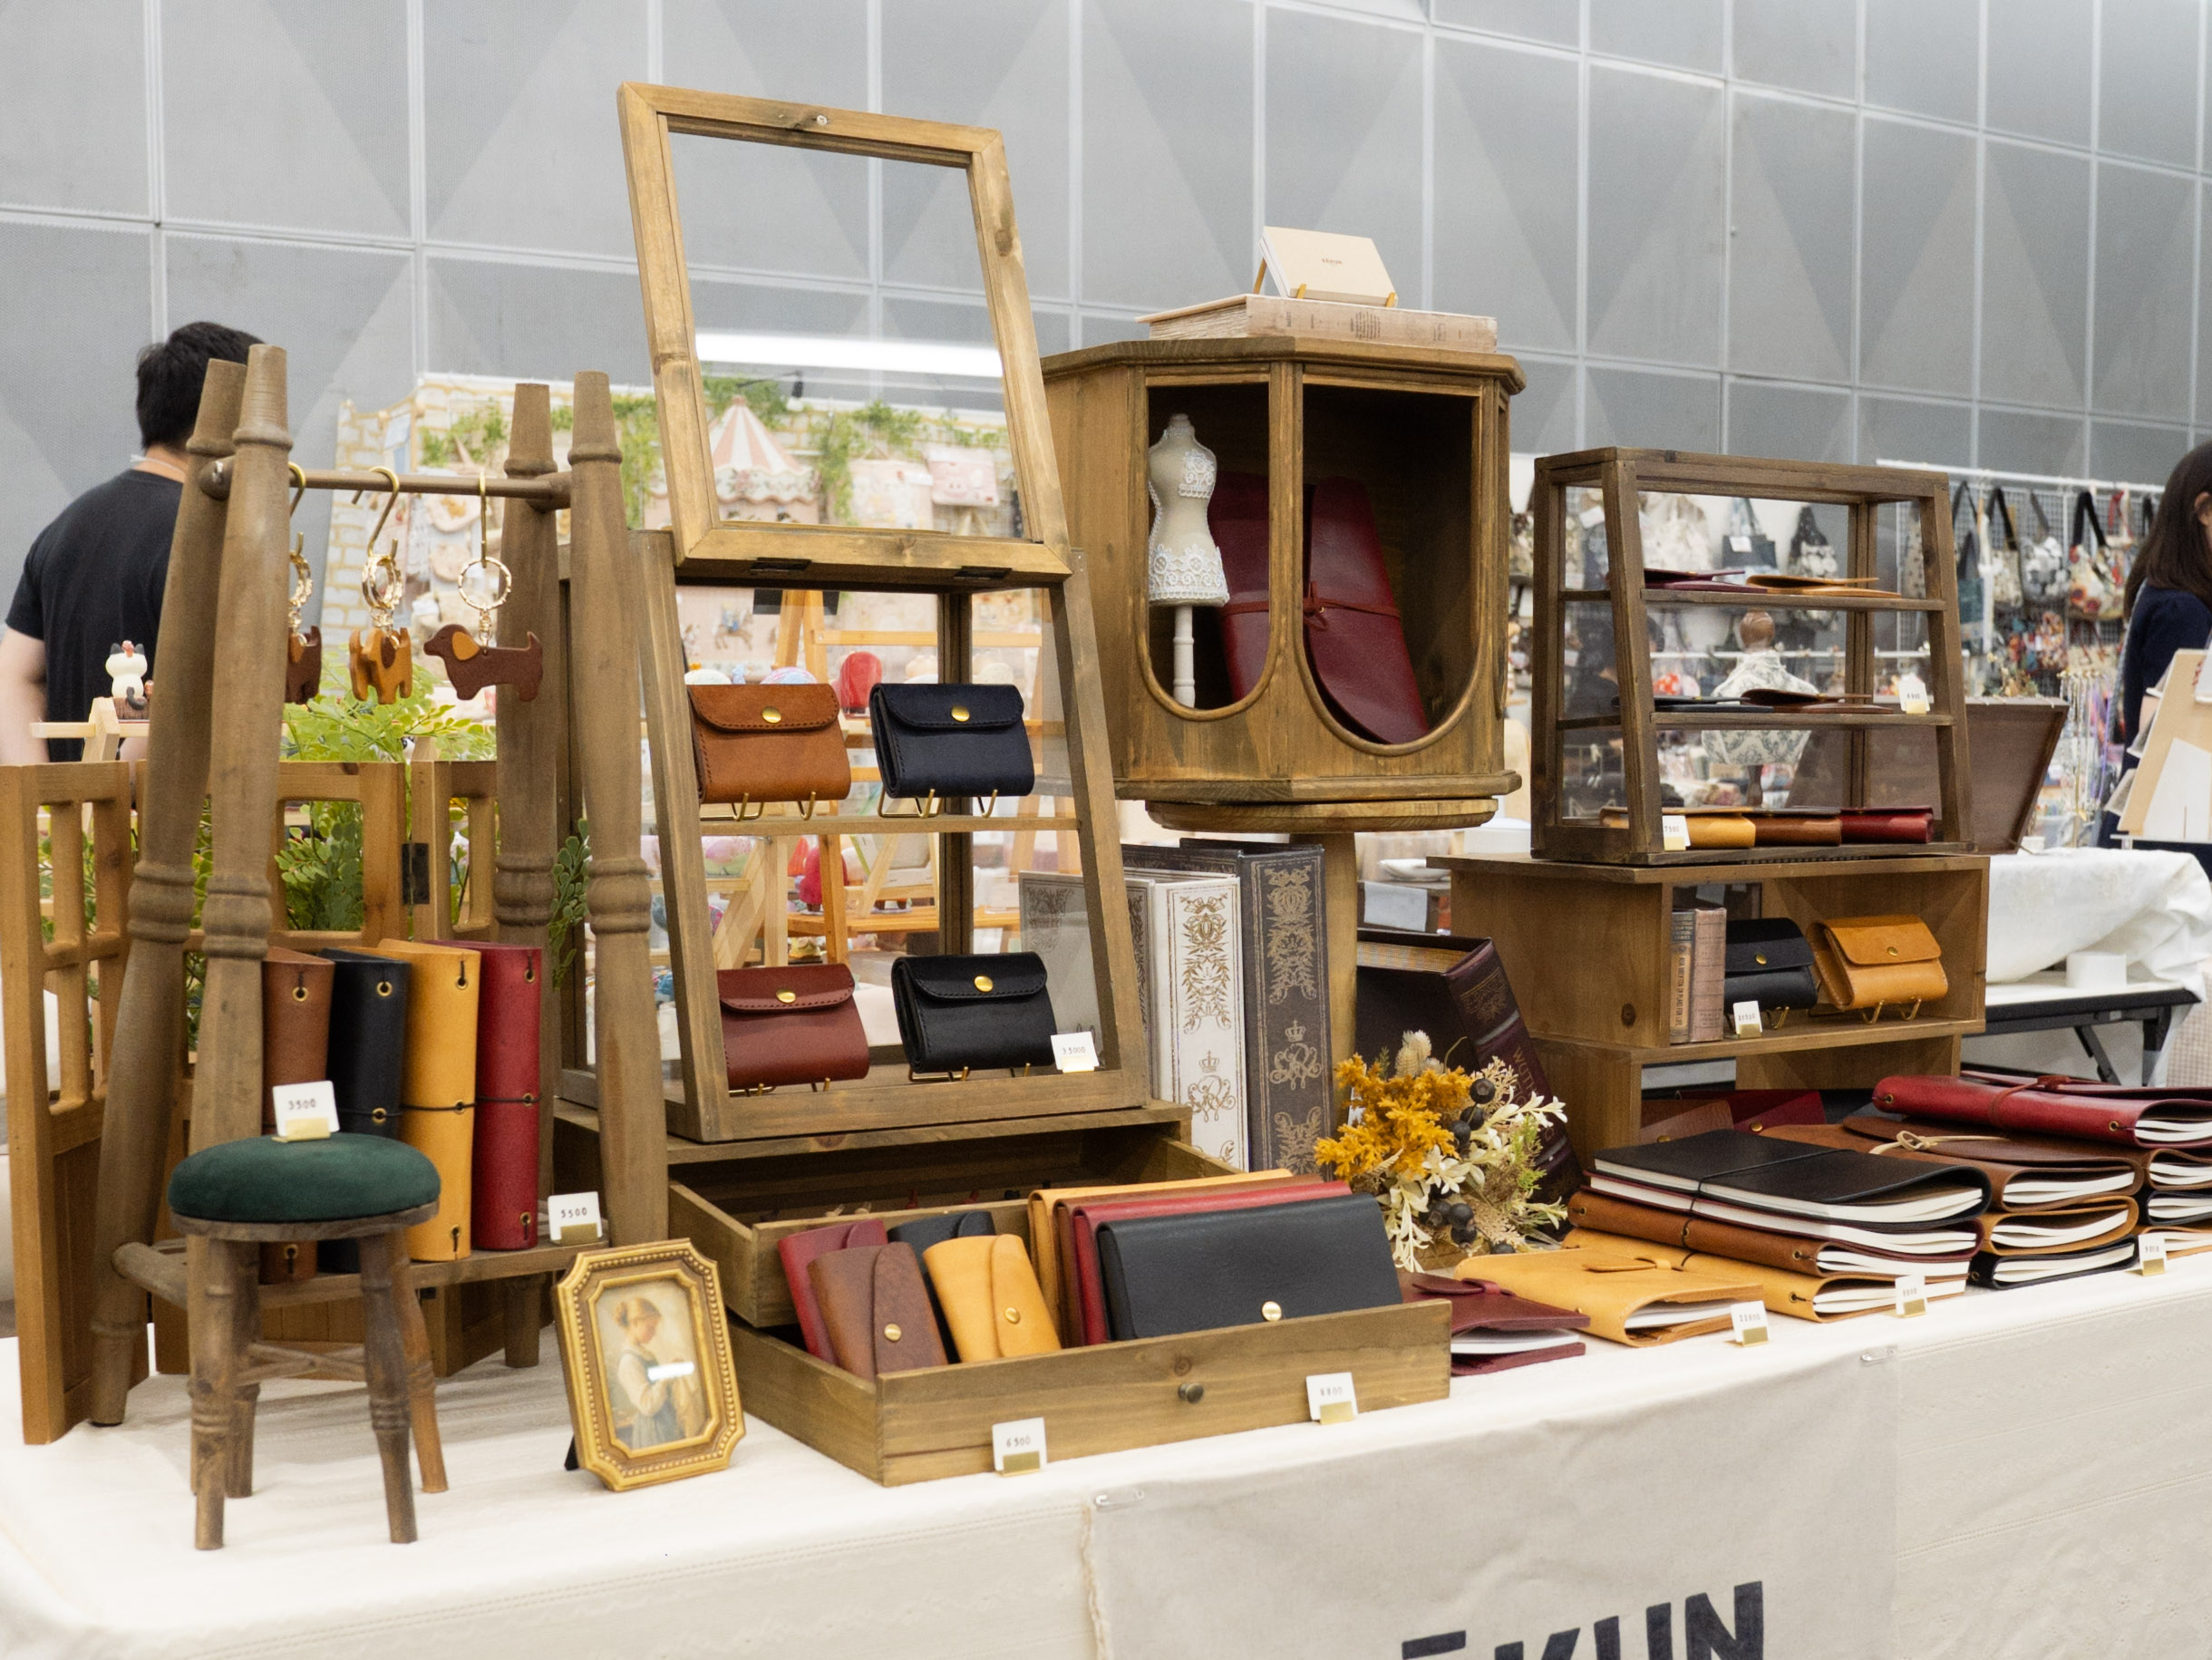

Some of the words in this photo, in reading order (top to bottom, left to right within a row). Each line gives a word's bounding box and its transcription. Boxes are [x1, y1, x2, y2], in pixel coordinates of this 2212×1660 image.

[288, 1098, 316, 1111] 3500
[560, 1207, 587, 1218] 5500
[1006, 1435, 1031, 1448] 6500
